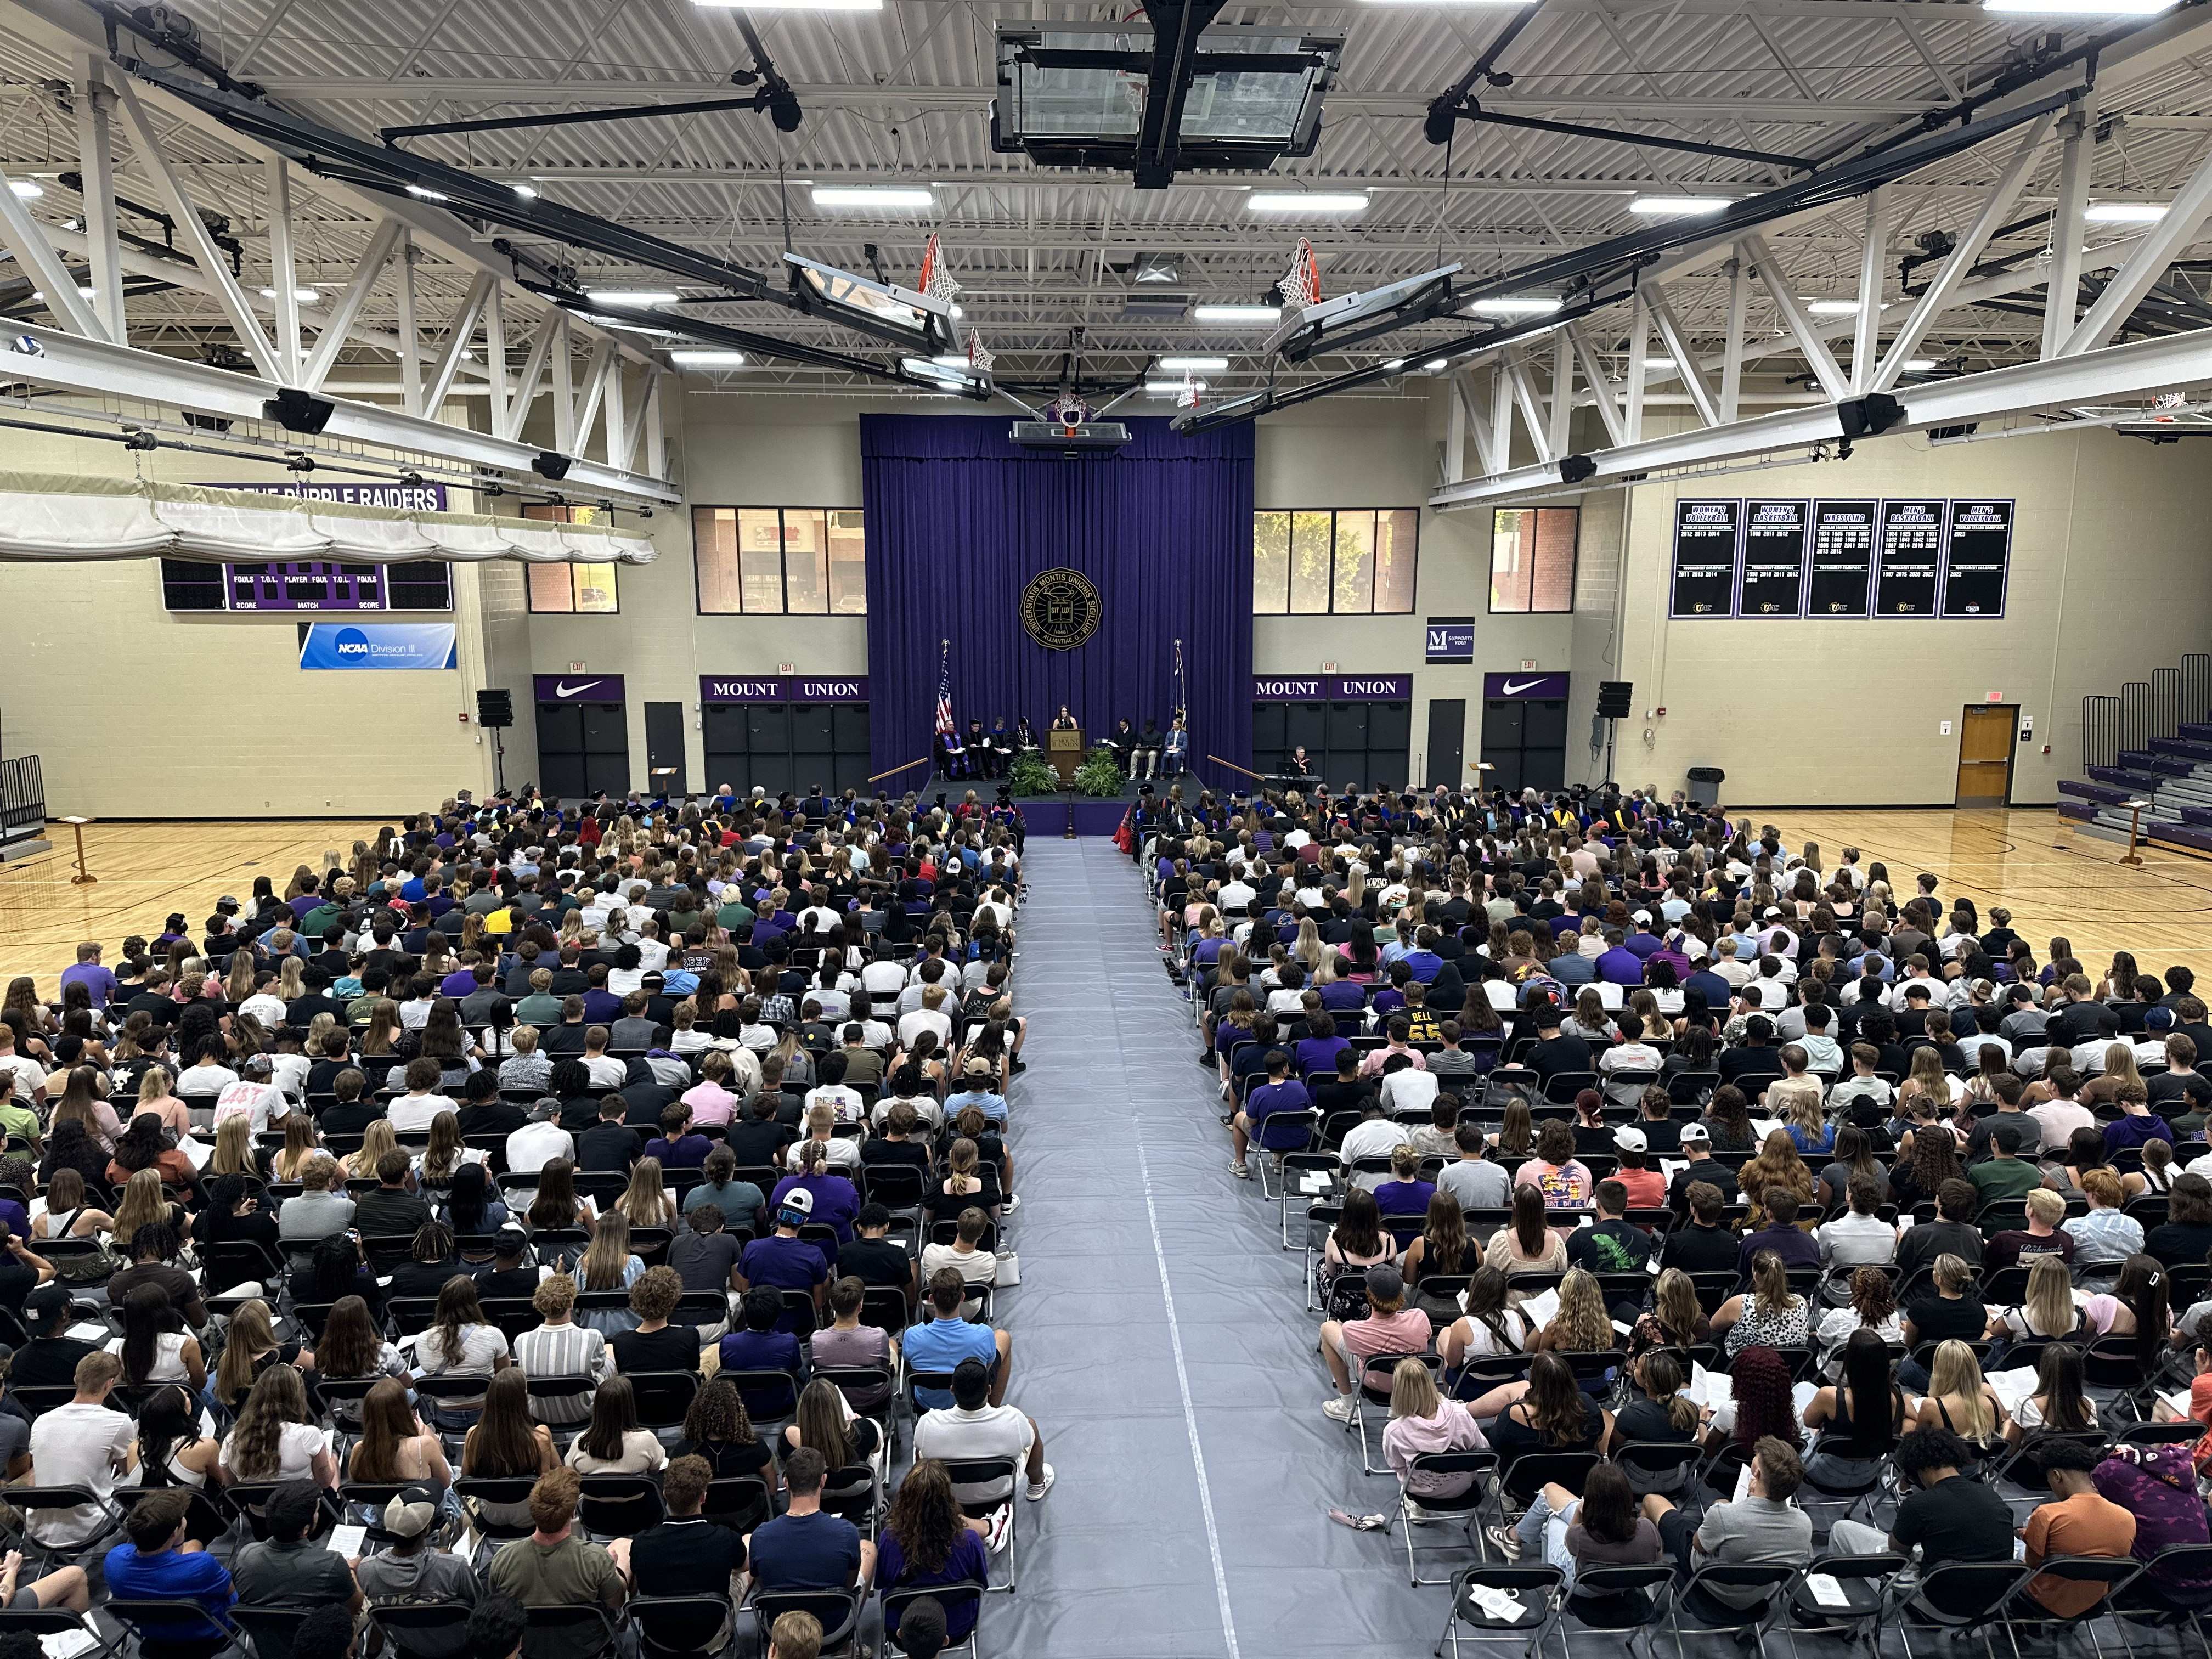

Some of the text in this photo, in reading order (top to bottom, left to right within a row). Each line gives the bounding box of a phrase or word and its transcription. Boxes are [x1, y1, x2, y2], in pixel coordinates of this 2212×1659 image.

[359, 488, 438, 511] RAIDERS
[1692, 505, 1726, 514] WOMEN'S
[1760, 505, 1795, 514] WOMEN'S
[1903, 506, 1925, 514] MEN'S
[1686, 514, 1728, 522] VOLLEYBALL
[1753, 514, 1798, 522] BASKETBALL
[1824, 514, 1865, 522] WRESTLING
[1890, 514, 1934, 522] BASKETBALL
[1960, 514, 2001, 522] VOLLEYBALL
[1039, 574, 1066, 587] MONTIS
[1068, 575, 1092, 598] UNIONIS
[1081, 600, 1096, 634] SIGILLUM
[338, 644, 368, 653] NCAA
[371, 644, 406, 653] Division
[713, 683, 859, 696] MOUNT UNION
[1256, 681, 1397, 695] MOUNT UNION
[1367, 878, 1388, 887] SCARFACE
[351, 1006, 368, 1015] SALTY
[1412, 1012, 1432, 1022] BELL
[1408, 1023, 1441, 1040] 55
